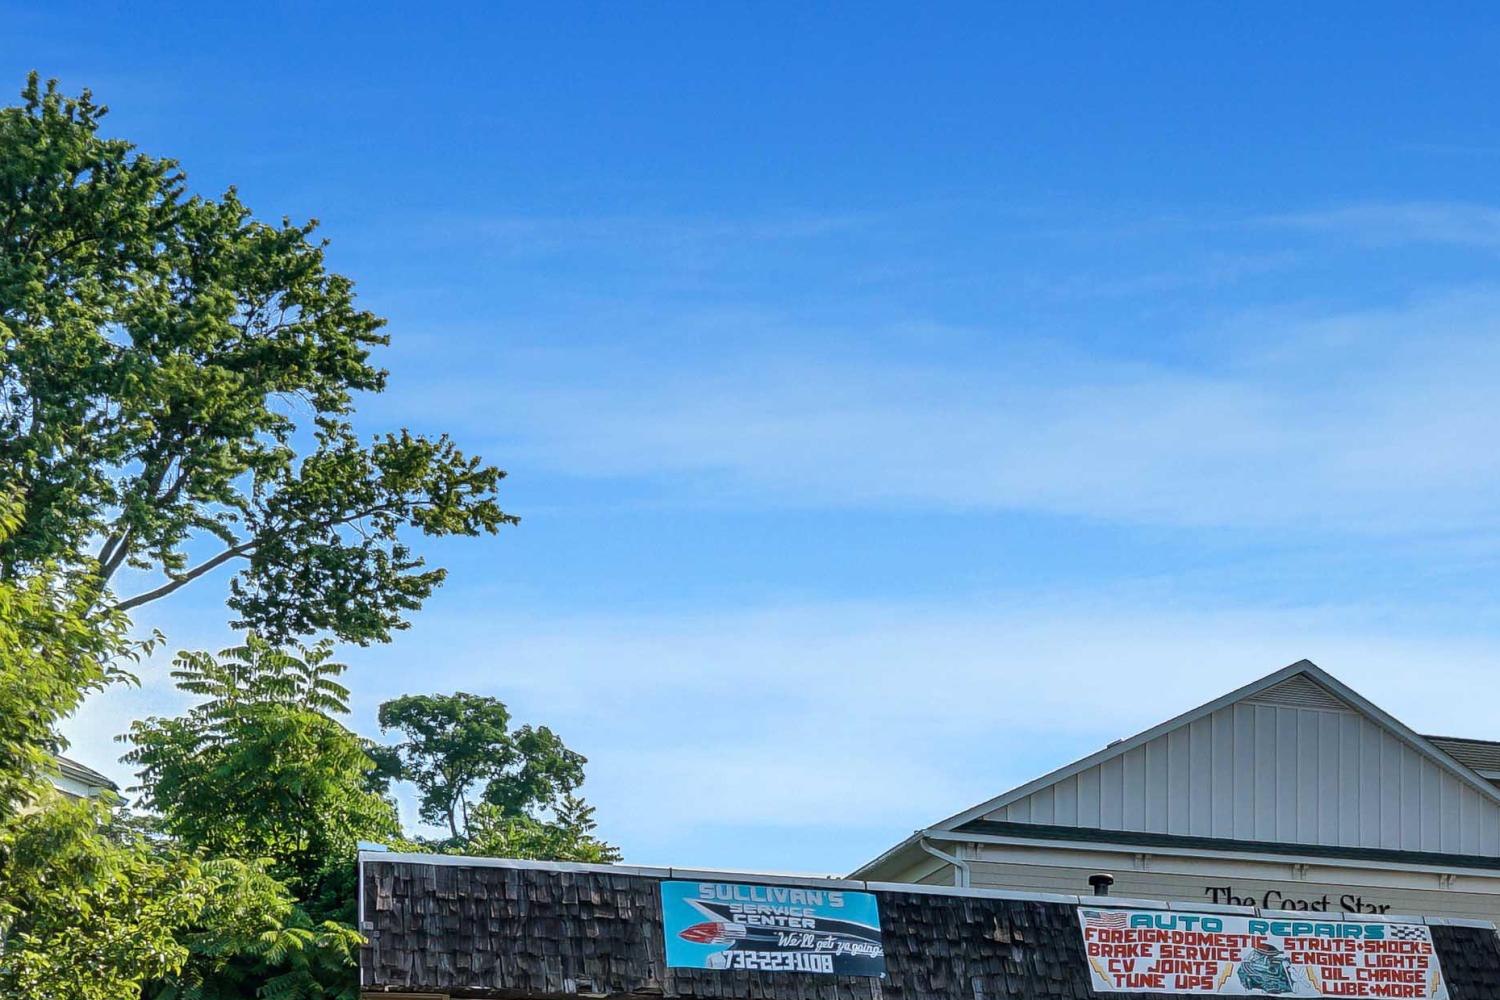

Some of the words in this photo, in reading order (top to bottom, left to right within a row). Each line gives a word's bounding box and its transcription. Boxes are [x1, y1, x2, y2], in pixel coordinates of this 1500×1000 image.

[699, 883, 844, 907] SULLIVAN'S
[1205, 887, 1256, 906] The
[1263, 890, 1330, 911] Coast
[1340, 894, 1391, 914] Star
[729, 903, 815, 917] SERVICE
[733, 914, 815, 929] CENTER
[1130, 914, 1222, 932] AUTO
[1249, 920, 1385, 939] REPAIRS
[816, 935, 837, 952] get
[1088, 943, 1152, 957] BRAKE
[1160, 945, 1242, 961] SERVICE
[723, 950, 834, 973] 732-223-1108
[1108, 958, 1135, 973] CV
[1148, 960, 1218, 975] JOINTS
[1291, 952, 1356, 966] ENGINE
[1364, 954, 1428, 968] LIGHTS
[1113, 974, 1165, 988] TUNE
[1175, 975, 1213, 990] UPS
[1321, 967, 1349, 981] OIL
[1356, 968, 1426, 983] CHANGE
